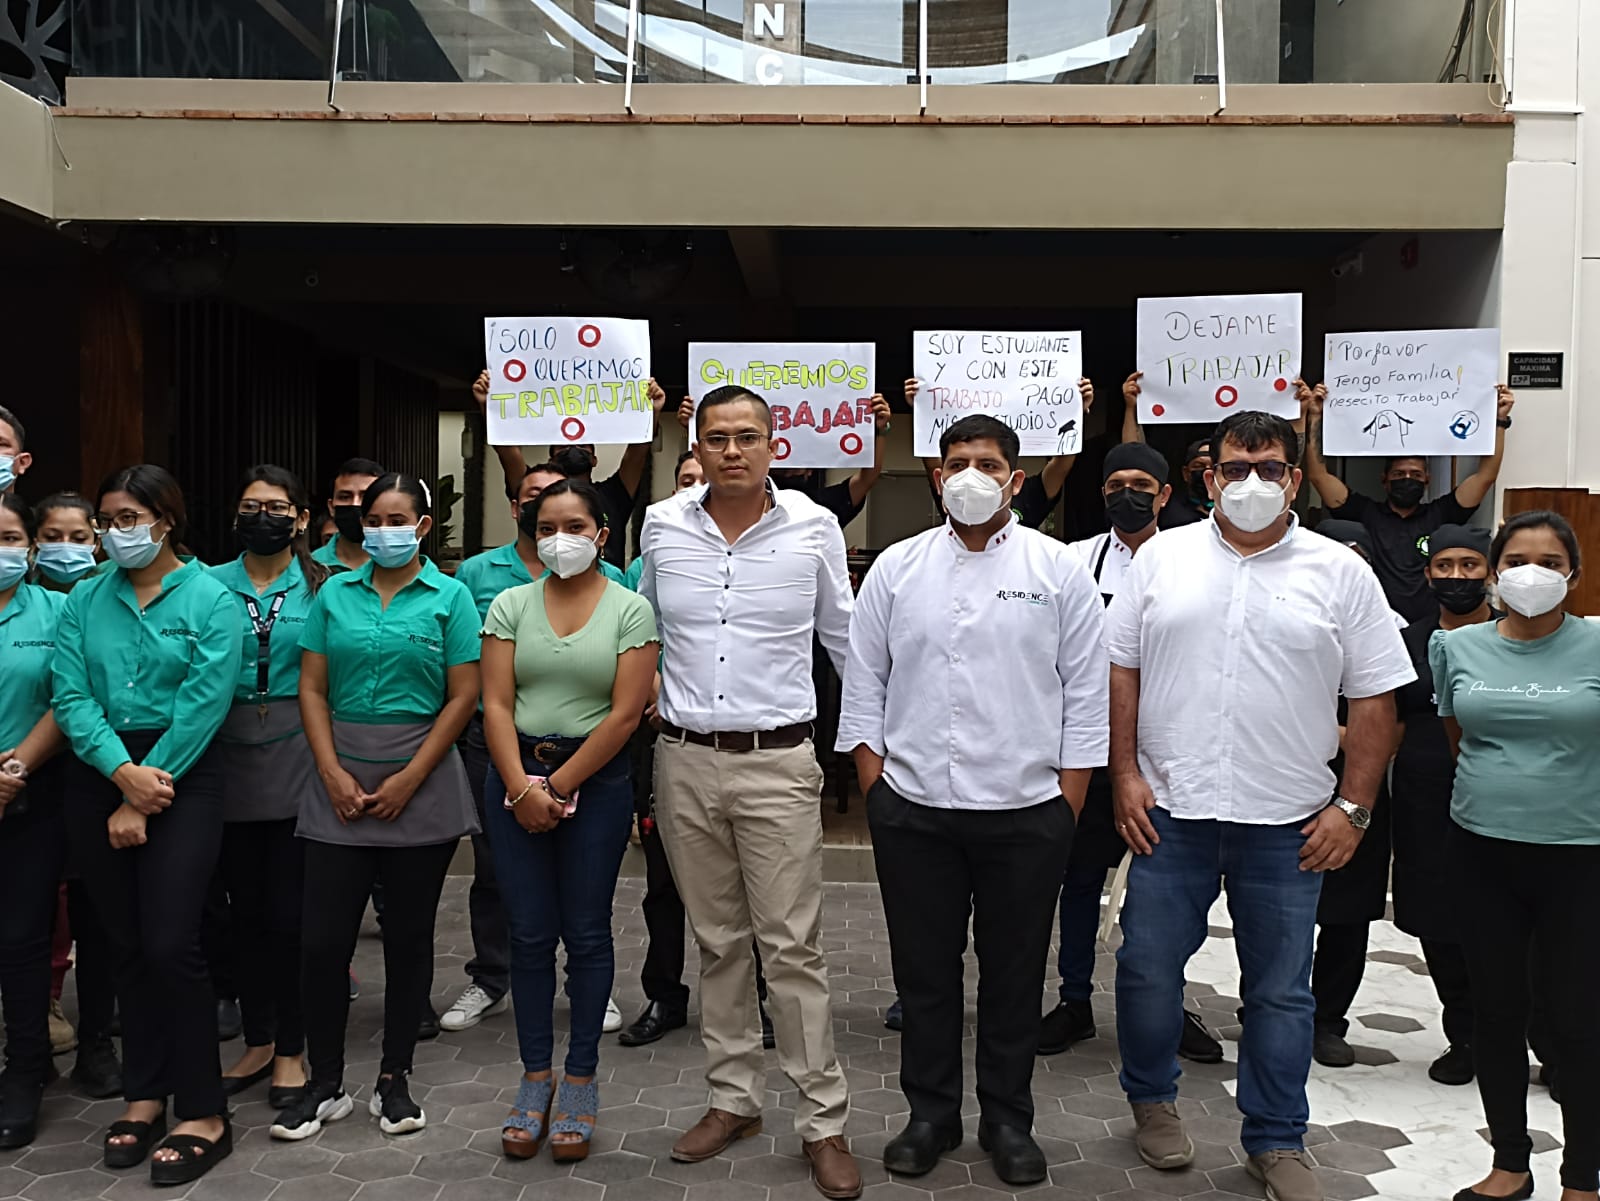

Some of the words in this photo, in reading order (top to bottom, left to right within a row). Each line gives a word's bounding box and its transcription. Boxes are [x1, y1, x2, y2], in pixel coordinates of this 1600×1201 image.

[1164, 311, 1277, 341] DEJAME
[928, 333, 965, 355] SOY
[534, 357, 643, 382] QUEREMOS
[700, 358, 868, 390] QUEREMOS
[934, 362, 946, 382] Y
[966, 360, 1006, 380] CON
[1019, 359, 1058, 378] ESTE
[1155, 348, 1295, 387] TRABAJAR
[927, 386, 1003, 411] TRABAJO
[1020, 383, 1074, 406] PAGO
[1334, 374, 1381, 392] Tengo
[490, 379, 654, 419] TRABAJAR
[769, 397, 873, 434] BAJAR
[996, 589, 1049, 603] RESIDENCE
